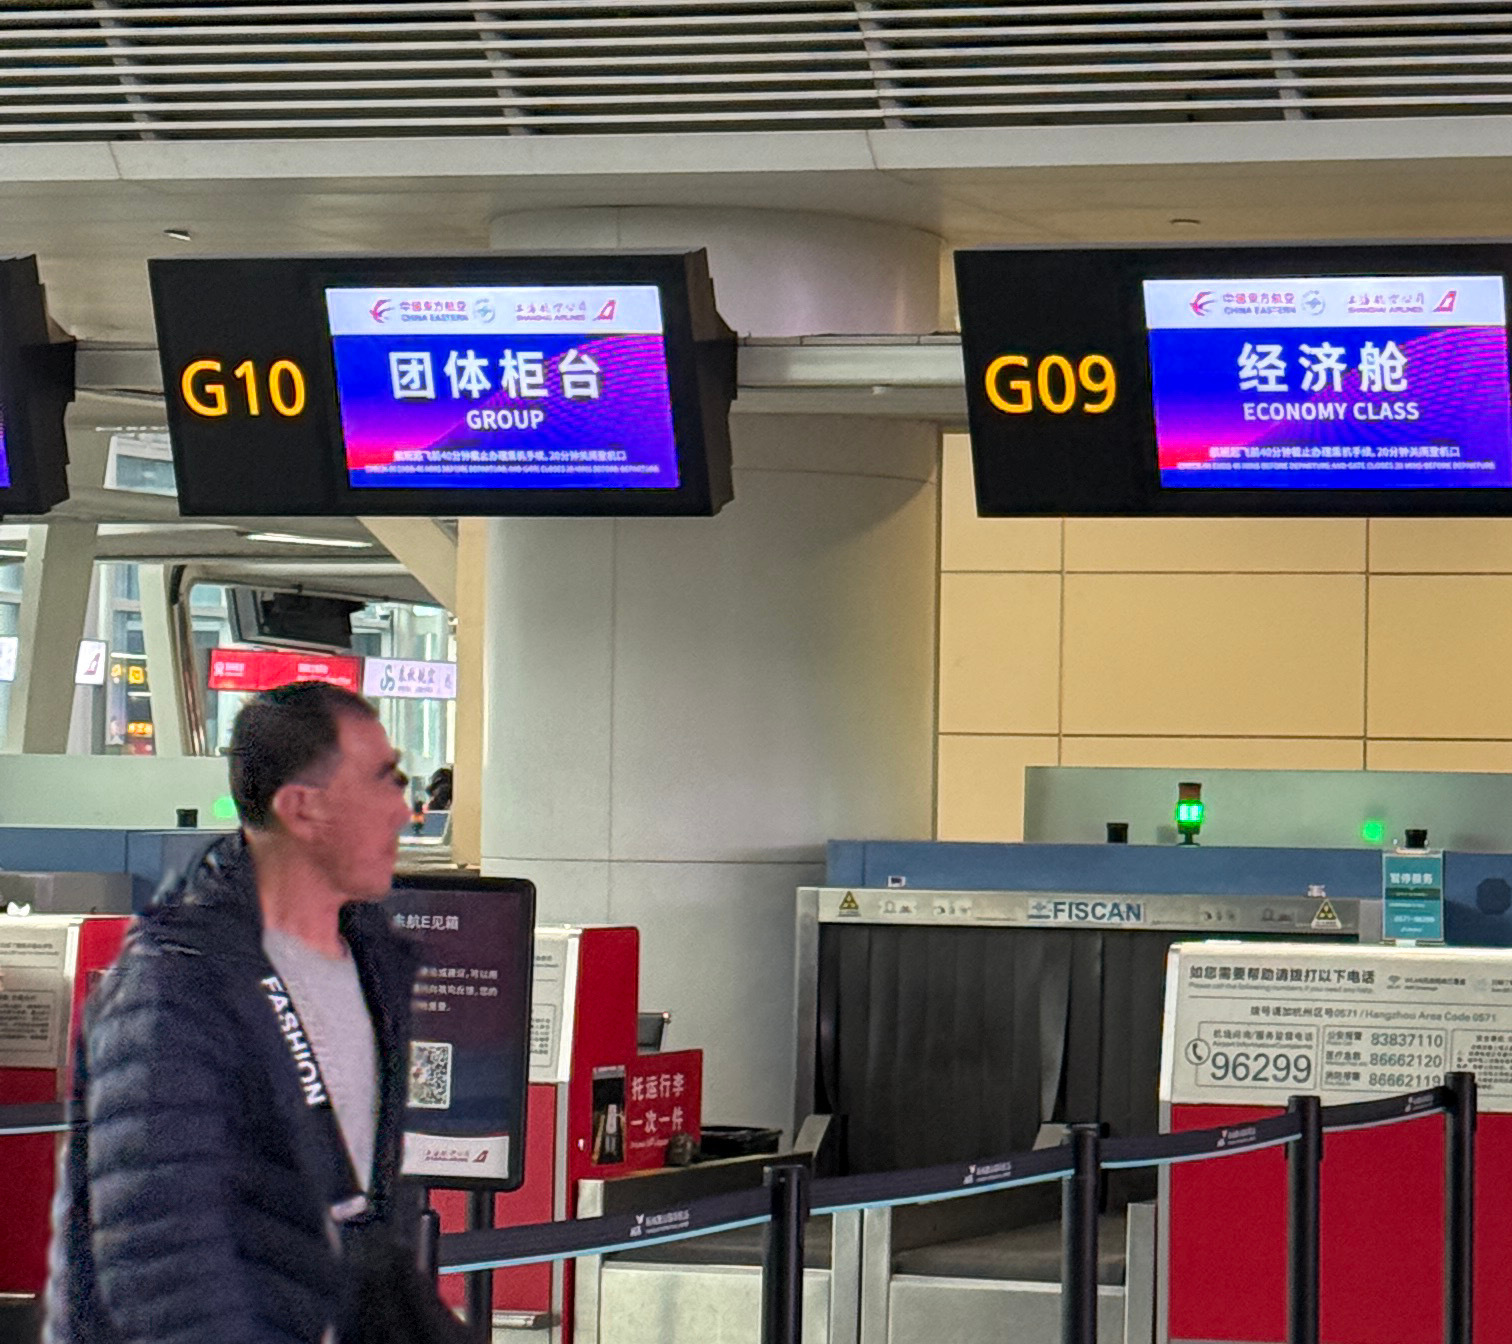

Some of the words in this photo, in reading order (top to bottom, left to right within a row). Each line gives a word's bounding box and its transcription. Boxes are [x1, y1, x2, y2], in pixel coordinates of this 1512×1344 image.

[388, 348, 600, 400] 团体柜台
[1237, 341, 1409, 393] 经济舱
[180, 359, 306, 417] G10
[985, 355, 1117, 414] G09
[466, 409, 545, 430] GROUP
[1243, 403, 1347, 421] ECONOMY
[1353, 402, 1420, 421] CLASS
[1053, 901, 1141, 921] FISCAN
[1189, 965, 1375, 985] 如您需要帮助请拨打以下电话
[260, 976, 327, 1106] FASHION
[1371, 1032, 1443, 1048] 83837110
[1210, 1051, 1312, 1084] 96299
[1369, 1052, 1442, 1068] 86662120
[631, 1072, 685, 1102] 托运行李
[1368, 1072, 1441, 1088] 86662119
[630, 1106, 684, 1134] 一次一件
